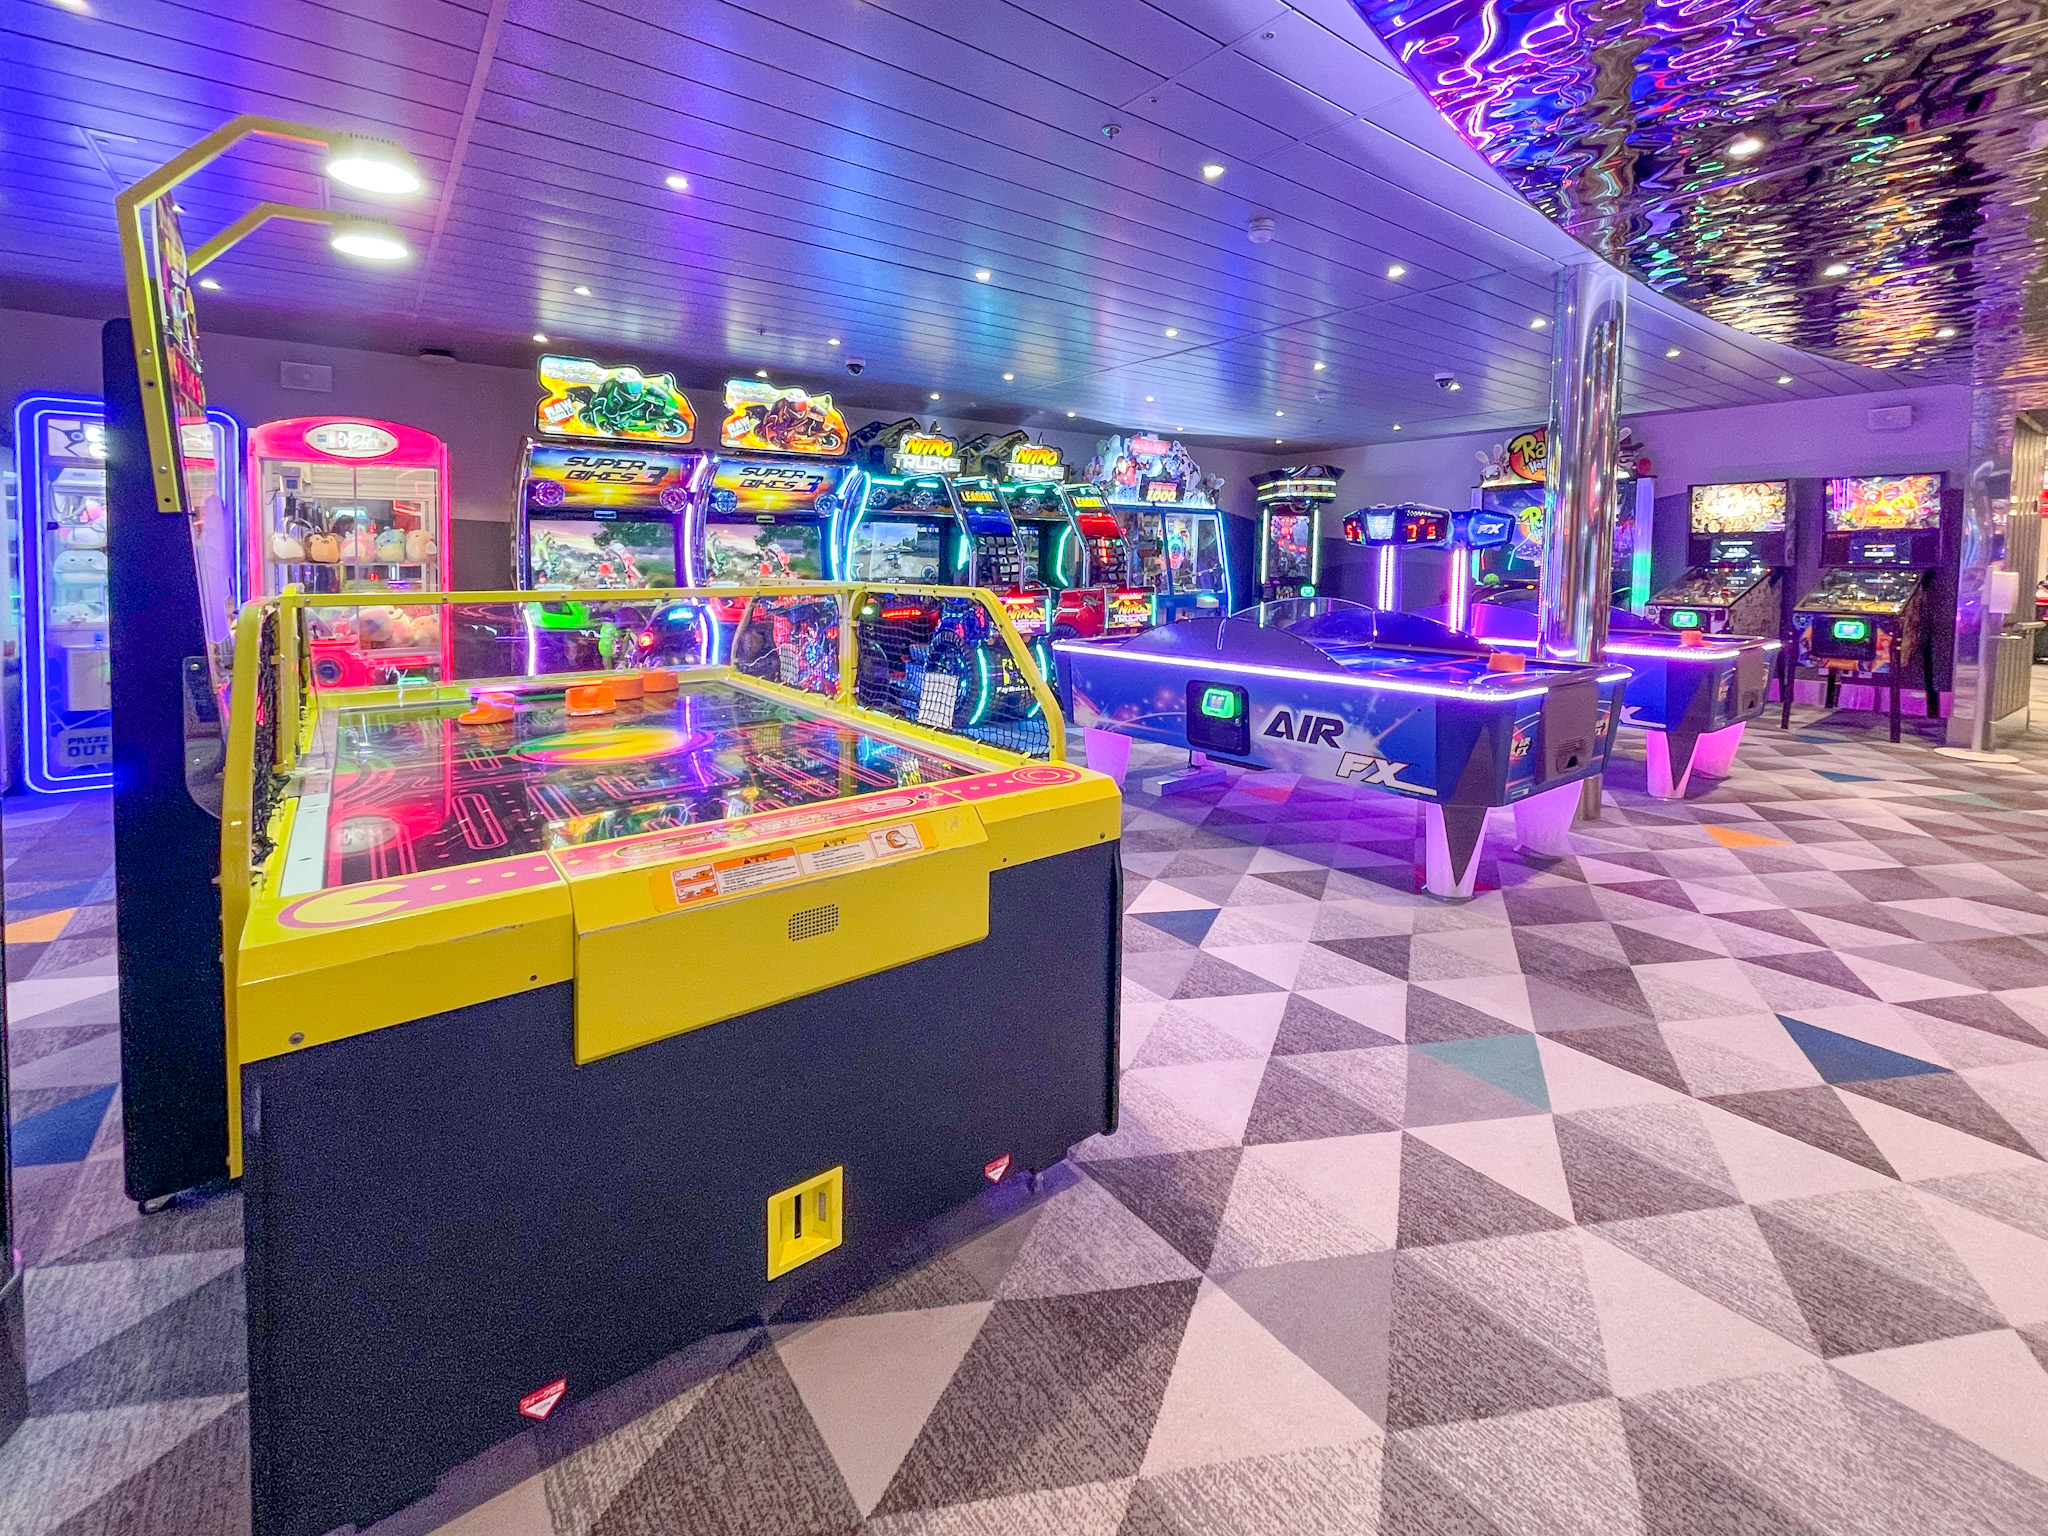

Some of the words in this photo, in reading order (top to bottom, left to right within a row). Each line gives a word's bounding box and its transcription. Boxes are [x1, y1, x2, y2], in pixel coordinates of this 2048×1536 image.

[544, 398, 573, 418] RAW
[726, 415, 750, 432] RAW
[904, 437, 954, 457] NITRO
[1511, 431, 1547, 464] Ra
[564, 456, 647, 471] SUPER
[893, 453, 962, 473] TRUCKS
[1015, 448, 1059, 466] NITRO
[564, 469, 638, 482] BIKES
[739, 467, 807, 479] SUPER
[1005, 462, 1065, 481] TRUCKS
[739, 478, 799, 490] BIKES
[1407, 524, 1418, 538] 7
[1427, 526, 1436, 537] 5
[1476, 523, 1504, 535] FX
[1264, 710, 1344, 749] AIR
[68, 735, 110, 746] PRIZE
[68, 744, 109, 758] OUT
[1335, 751, 1438, 797] FX
